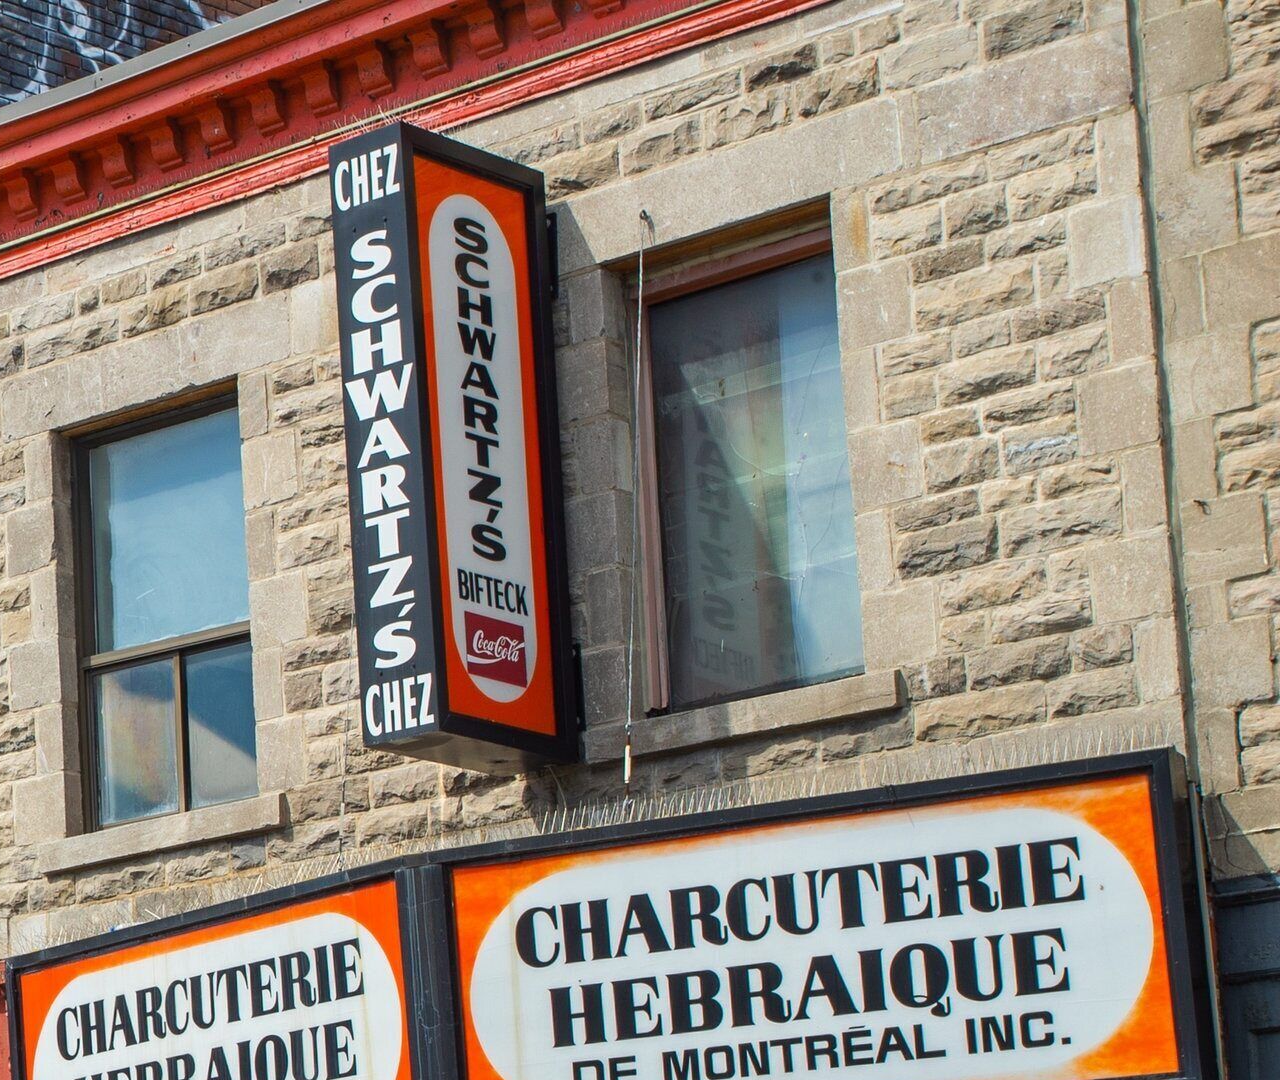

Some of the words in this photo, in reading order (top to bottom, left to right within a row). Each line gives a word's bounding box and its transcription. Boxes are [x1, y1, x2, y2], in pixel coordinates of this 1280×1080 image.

[334, 143, 400, 212] CHEZ
[343, 228, 417, 670] SCHWARTZ'S
[452, 216, 508, 564] SCHWARTZ'S
[456, 567, 529, 617] BIFTECK
[365, 673, 435, 737] CHEZ
[516, 836, 1087, 970] CHARCUTERIE
[55, 937, 366, 1064] CHARCUTERIE
[550, 927, 1072, 1049] HEBRAIQUE
[967, 1008, 1074, 1055] INC.
